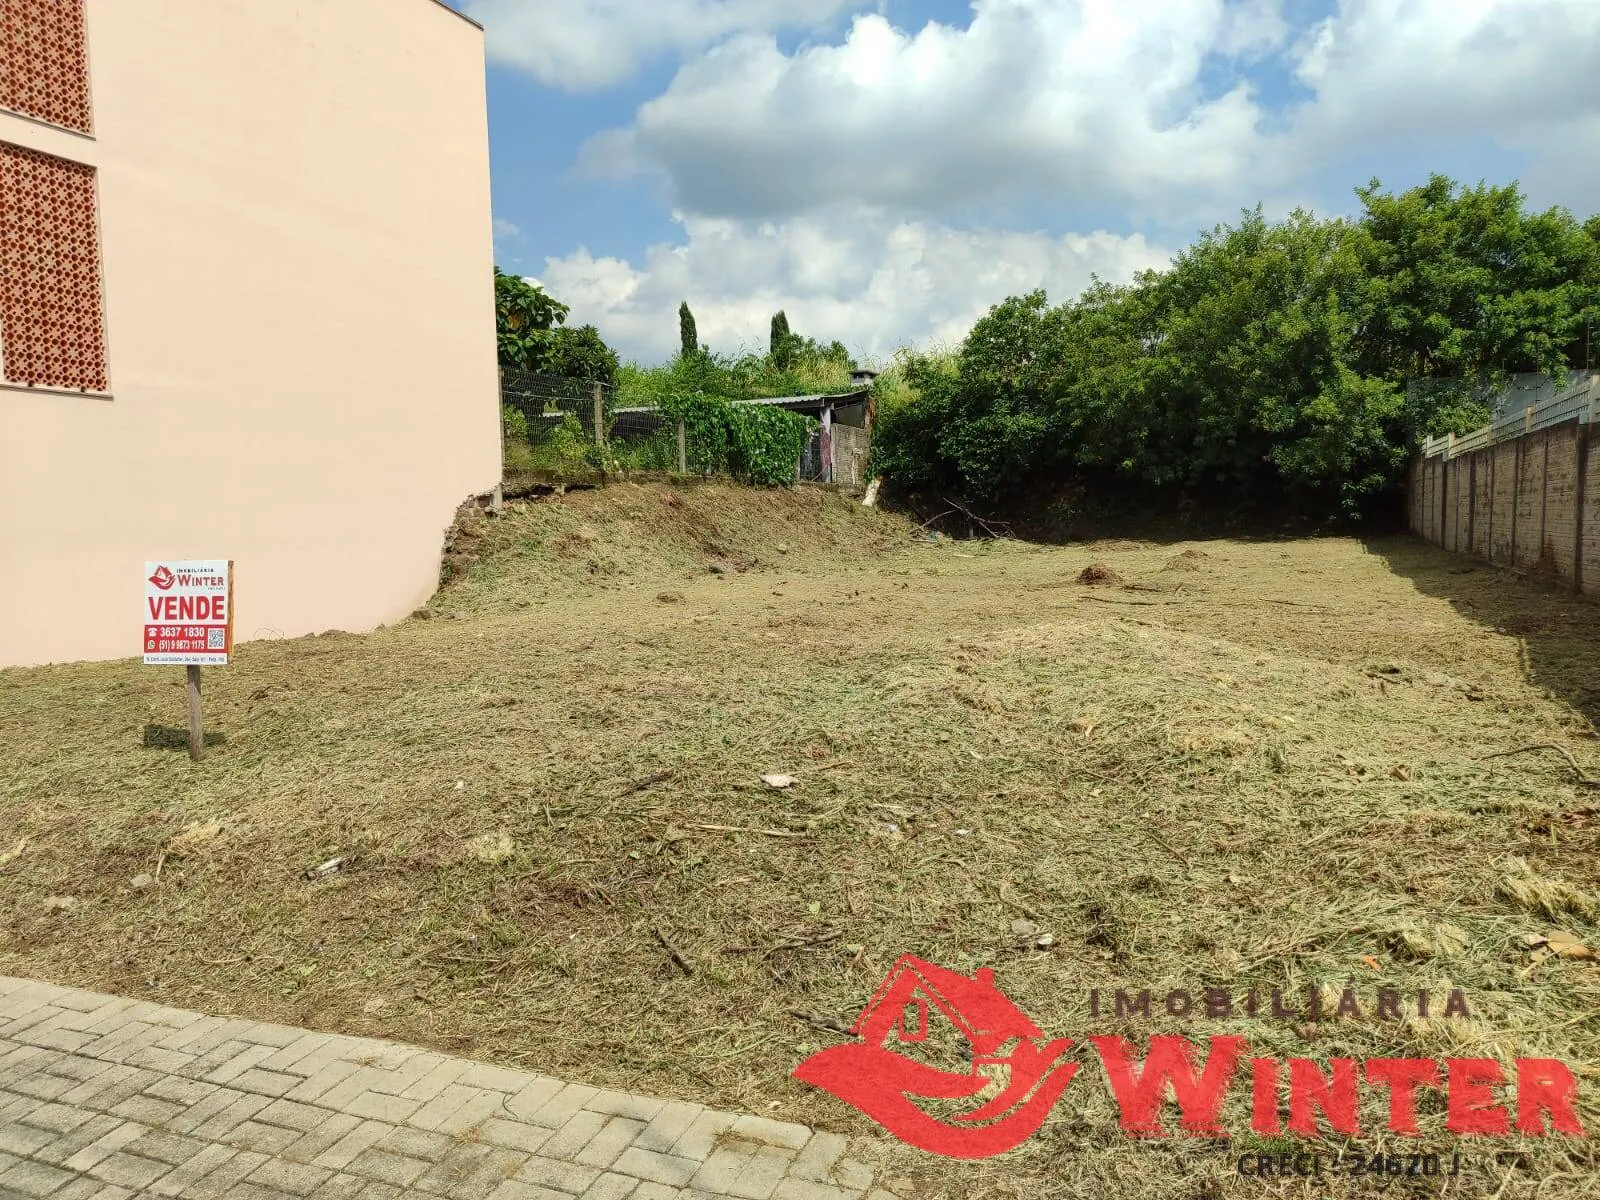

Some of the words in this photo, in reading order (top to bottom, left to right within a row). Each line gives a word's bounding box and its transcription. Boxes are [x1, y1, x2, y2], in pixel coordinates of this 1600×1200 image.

[177, 574, 225, 586] WINTER
[148, 596, 225, 620] VENDE
[160, 627, 181, 637] 3637
[184, 627, 205, 637] 1830
